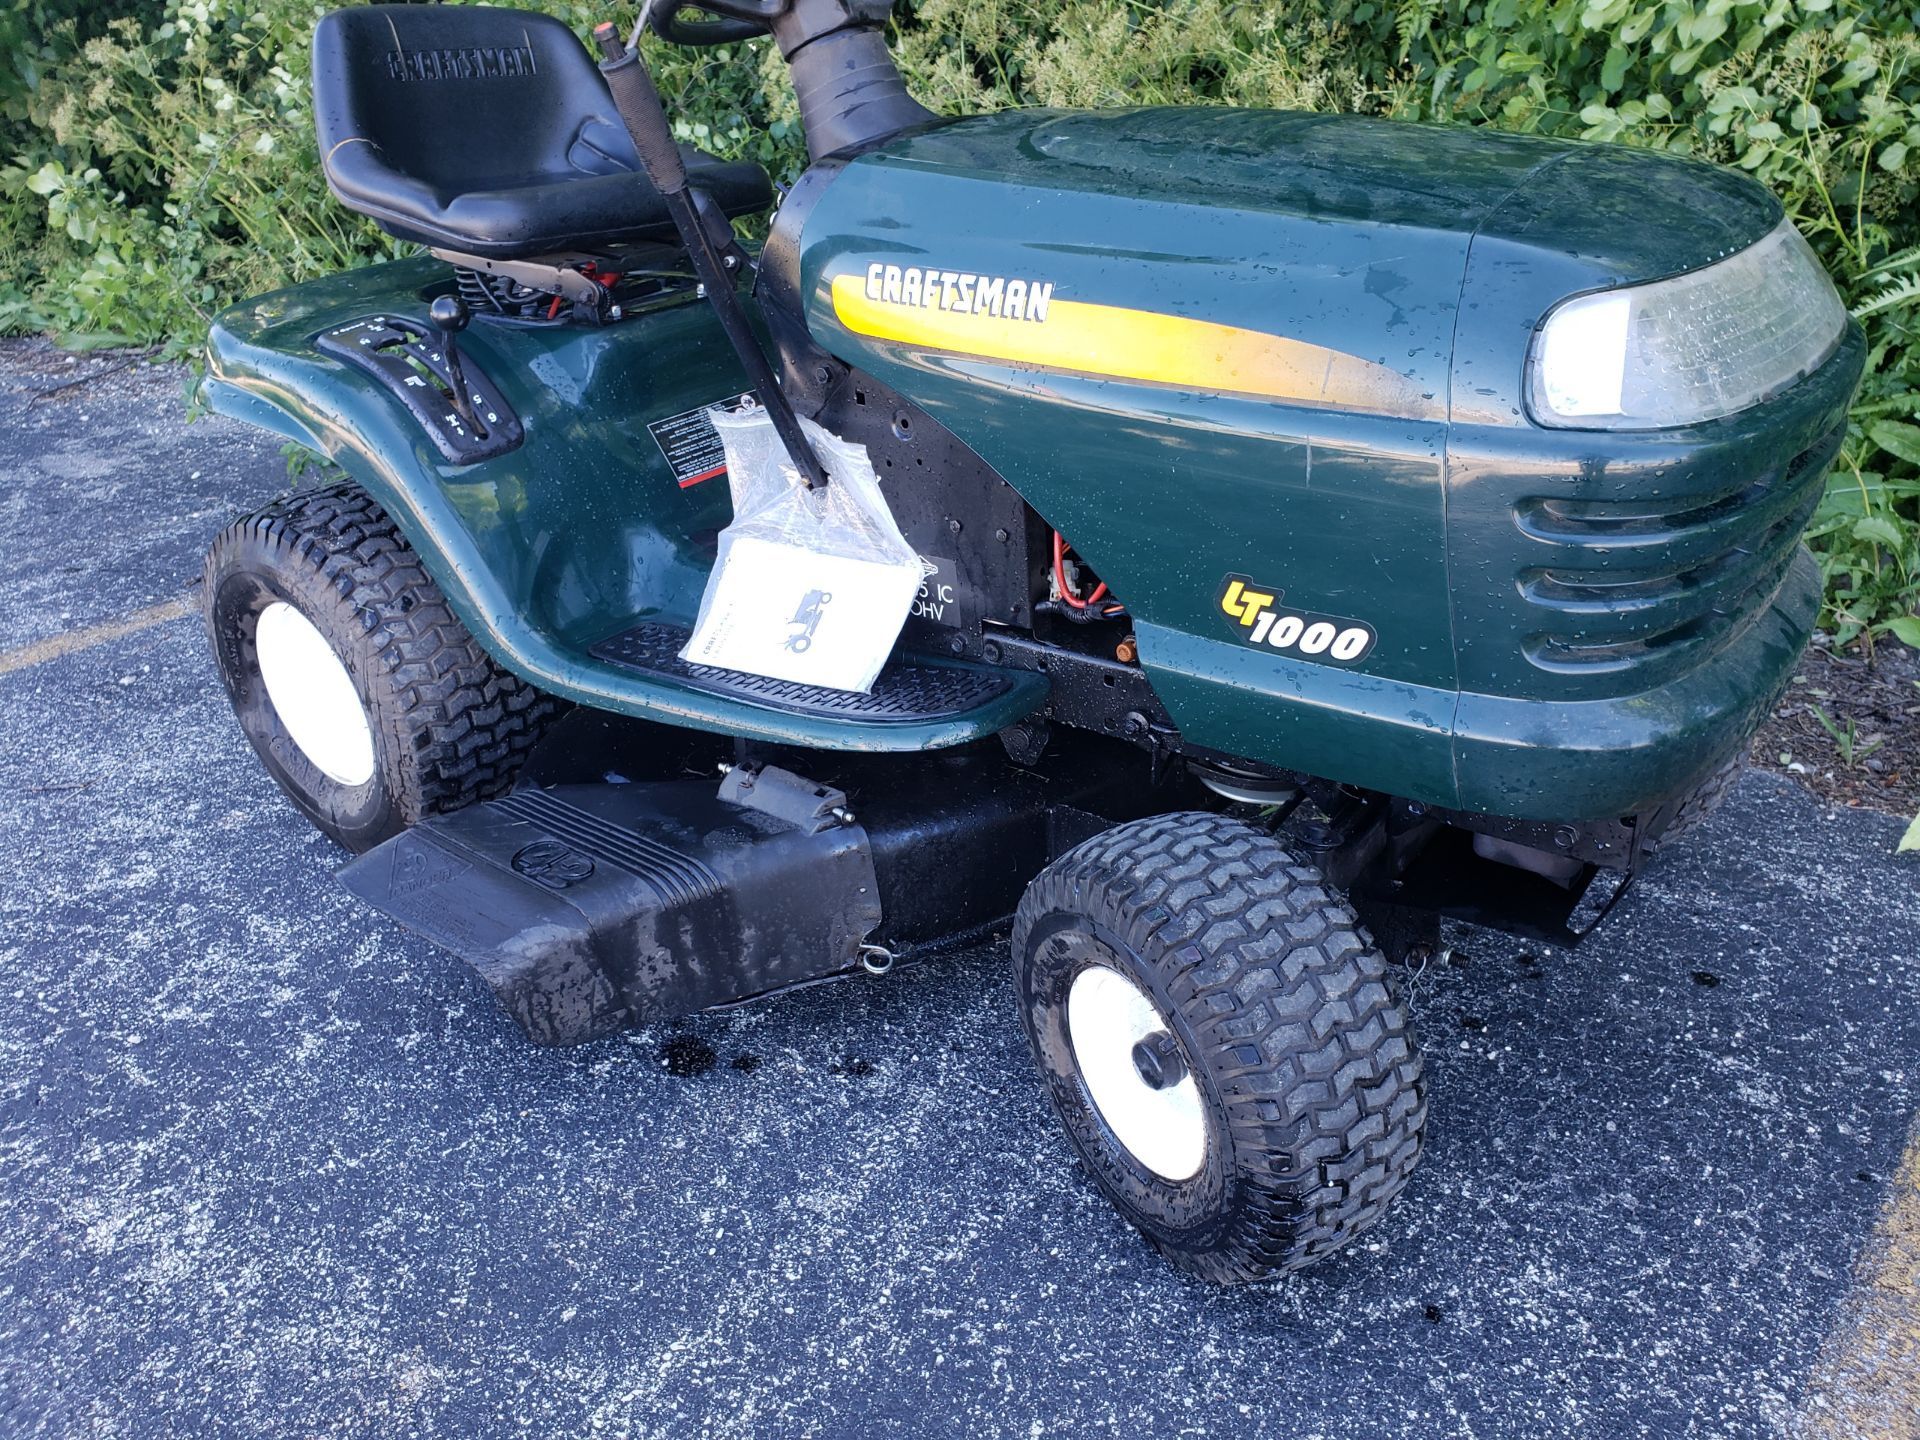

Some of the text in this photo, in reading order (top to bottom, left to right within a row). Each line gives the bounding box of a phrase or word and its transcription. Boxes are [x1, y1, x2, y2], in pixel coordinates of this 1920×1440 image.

[387, 47, 536, 81] CRAFTSMAN
[865, 262, 1053, 323] CRAFTSMAN
[431, 353, 440, 361] 2
[473, 394, 482, 404] 5
[487, 412, 497, 422] 6
[910, 601, 943, 621] OHV
[1222, 581, 1369, 661] LT 1000
